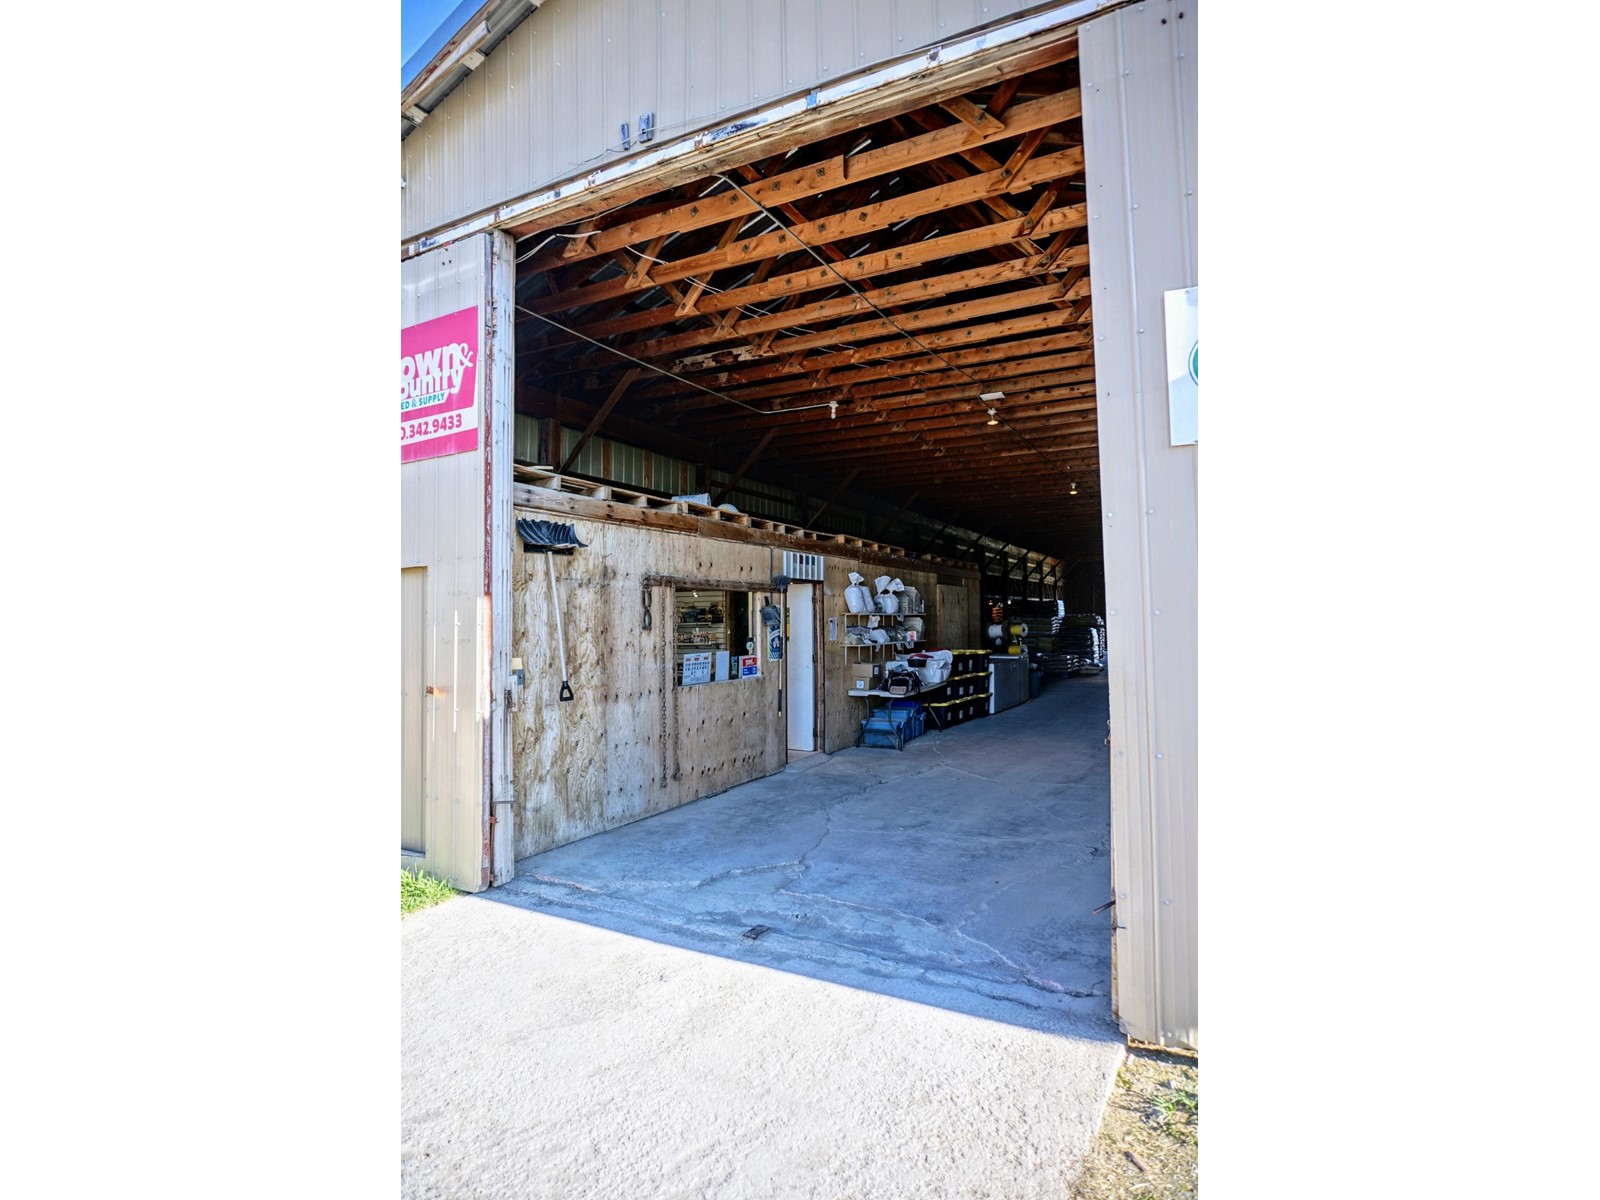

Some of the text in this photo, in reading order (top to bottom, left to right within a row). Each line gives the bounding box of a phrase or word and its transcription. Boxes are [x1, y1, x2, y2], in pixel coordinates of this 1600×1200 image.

[459, 343, 474, 368] &
[411, 399, 417, 408] &
[418, 392, 445, 406] SUPPLY
